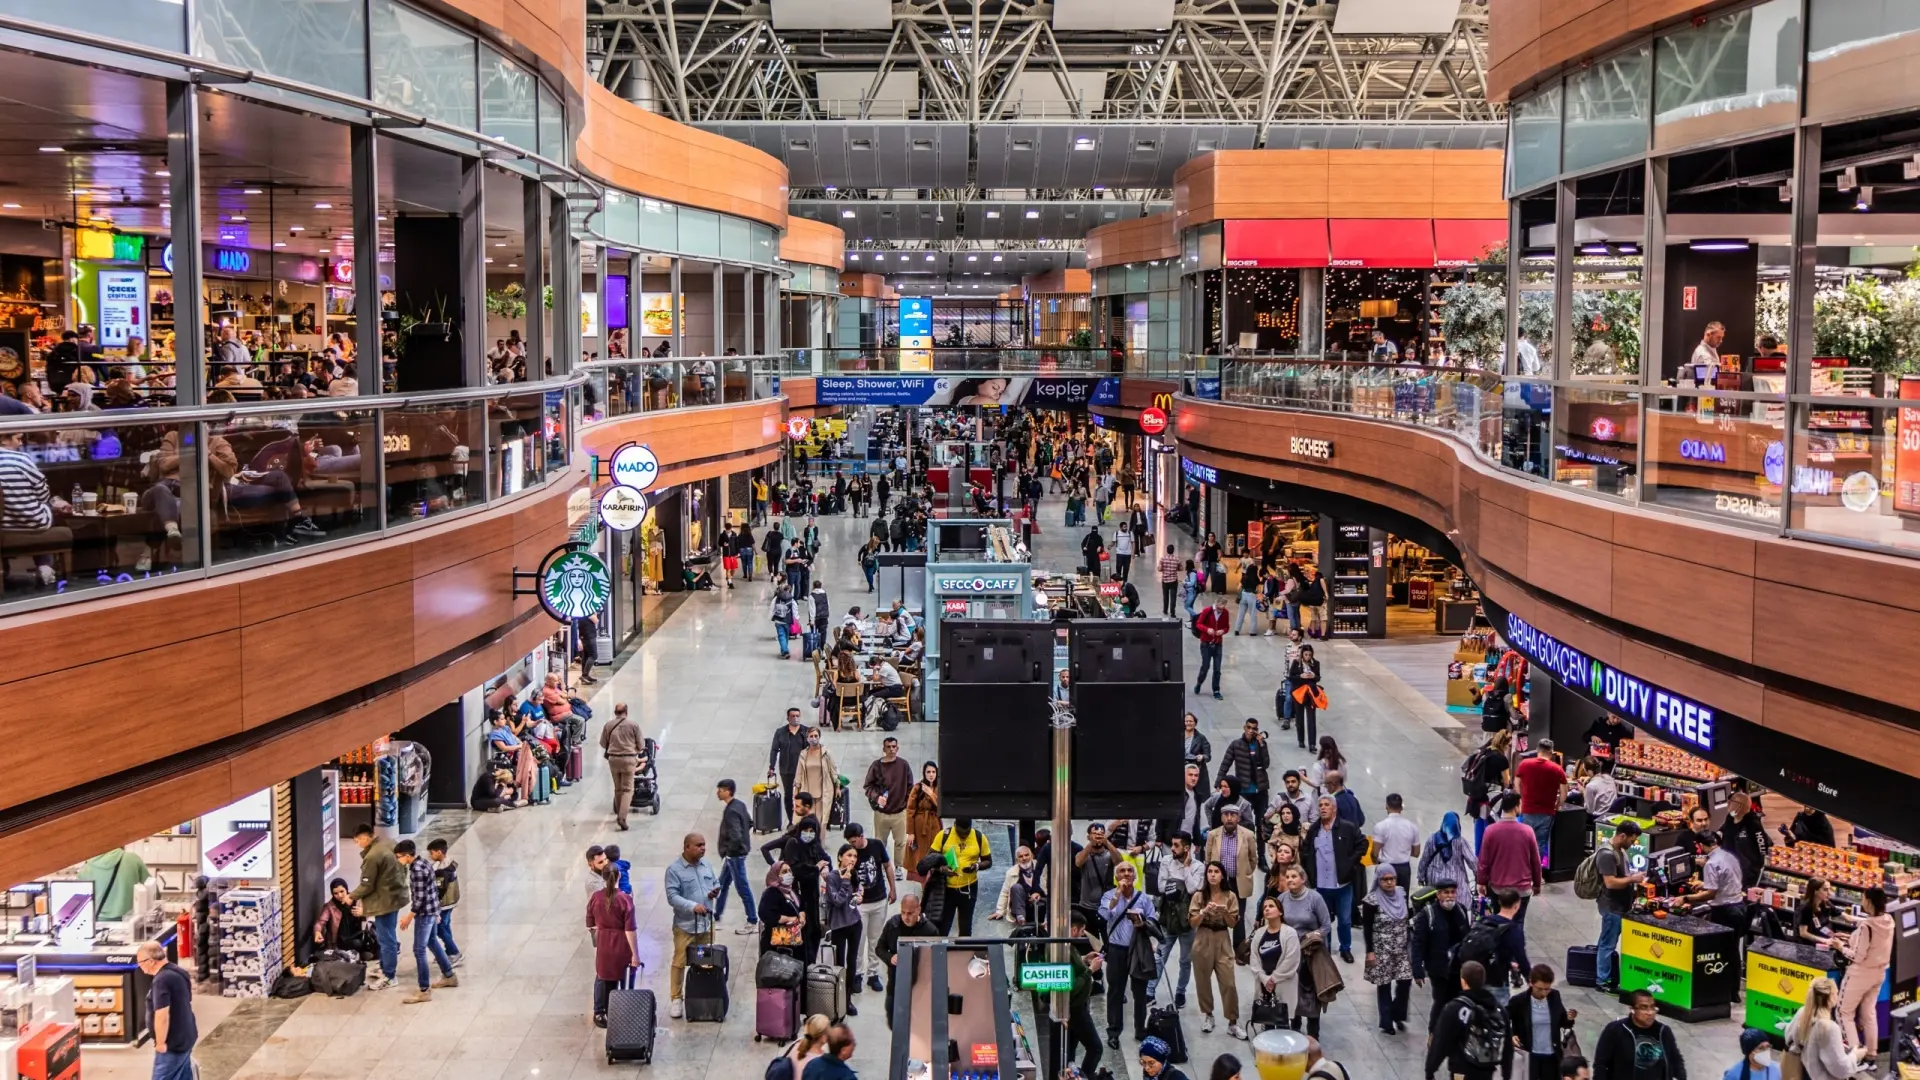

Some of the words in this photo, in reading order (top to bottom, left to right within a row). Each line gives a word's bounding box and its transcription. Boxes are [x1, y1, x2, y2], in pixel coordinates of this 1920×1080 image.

[220, 250, 250, 272] MADO
[822, 380, 855, 389] Sleep,
[857, 380, 899, 389] Shower,
[902, 380, 924, 388] WiFi
[1036, 381, 1088, 398] kepler
[1904, 408, 1920, 422] Sav
[1291, 436, 1328, 459] BIGCHEFS
[617, 462, 655, 472] MADO
[1206, 468, 1216, 483] FREE
[1538, 634, 1587, 686] GÖKÇEN
[1606, 668, 1651, 720] DUTY
[1656, 692, 1712, 748] FREE
[1780, 768, 1785, 777] A
[1818, 782, 1838, 797] Store
[1632, 929, 1650, 938] FEELING
[1651, 932, 1682, 947] HUNGRY?
[1697, 953, 1715, 962] SNACK
[1024, 970, 1068, 979] CASHIER
[1634, 966, 1652, 976] MOMENT
[1662, 970, 1683, 984] MINT?
[1704, 962, 1728, 975] GO
[1758, 963, 1778, 974] FEELING
[1780, 966, 1814, 982] HUNGRY?
[1892, 991, 1906, 1003] SNACK
[1760, 1002, 1780, 1012] MOMENT
